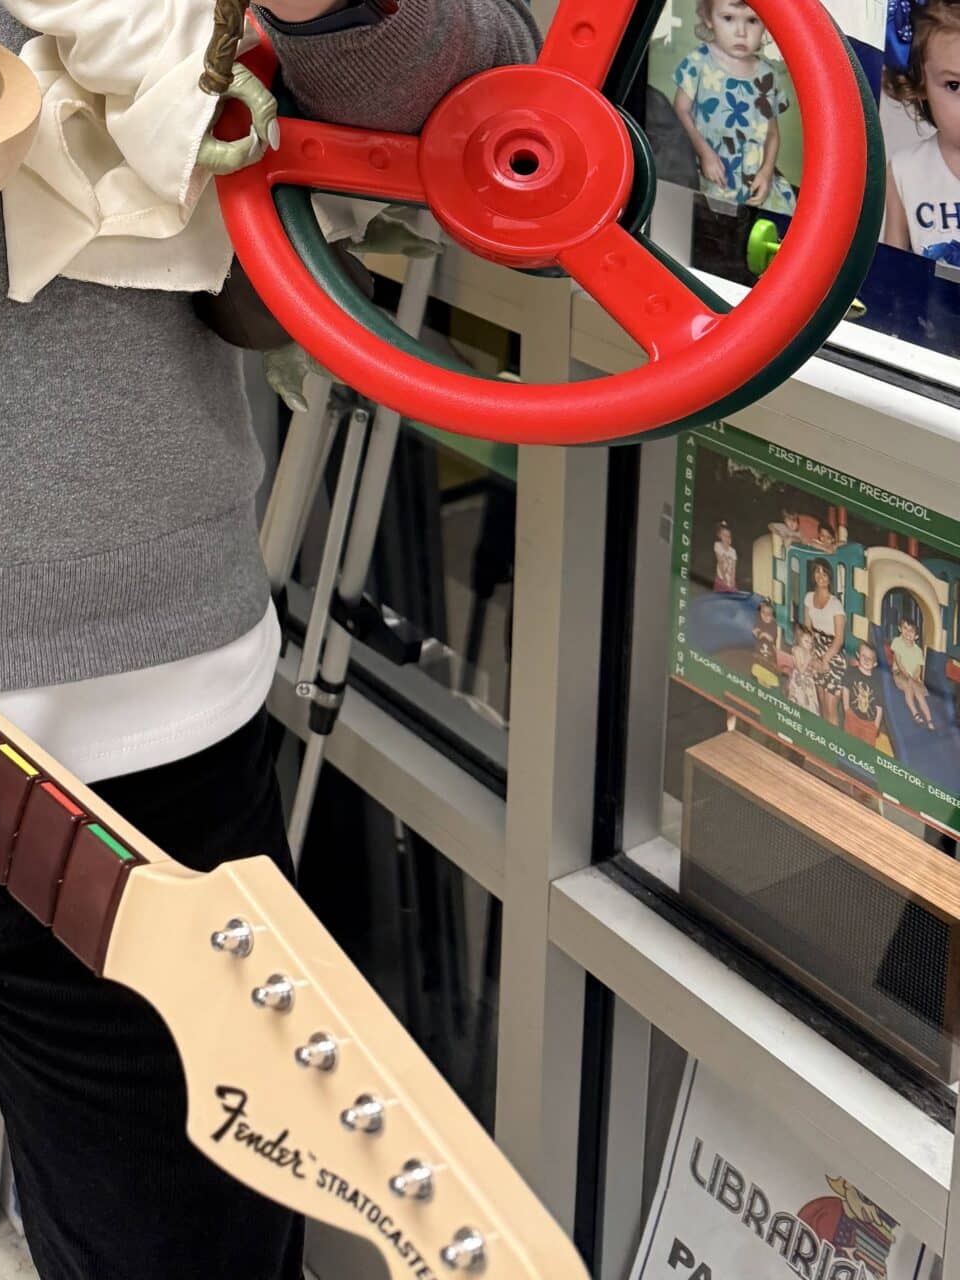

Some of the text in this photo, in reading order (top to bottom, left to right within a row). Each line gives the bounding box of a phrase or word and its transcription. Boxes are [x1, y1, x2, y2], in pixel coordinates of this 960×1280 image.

[768, 443, 931, 521] FIRST BAPTIST PRESCHOOL
[726, 672, 756, 693] ASHLEY
[777, 712, 876, 775] THREE YEAR OLD CLASS
[876, 755, 926, 789] DIRECTOR:
[210, 1084, 438, 1280] Fender STRATOCASTE
